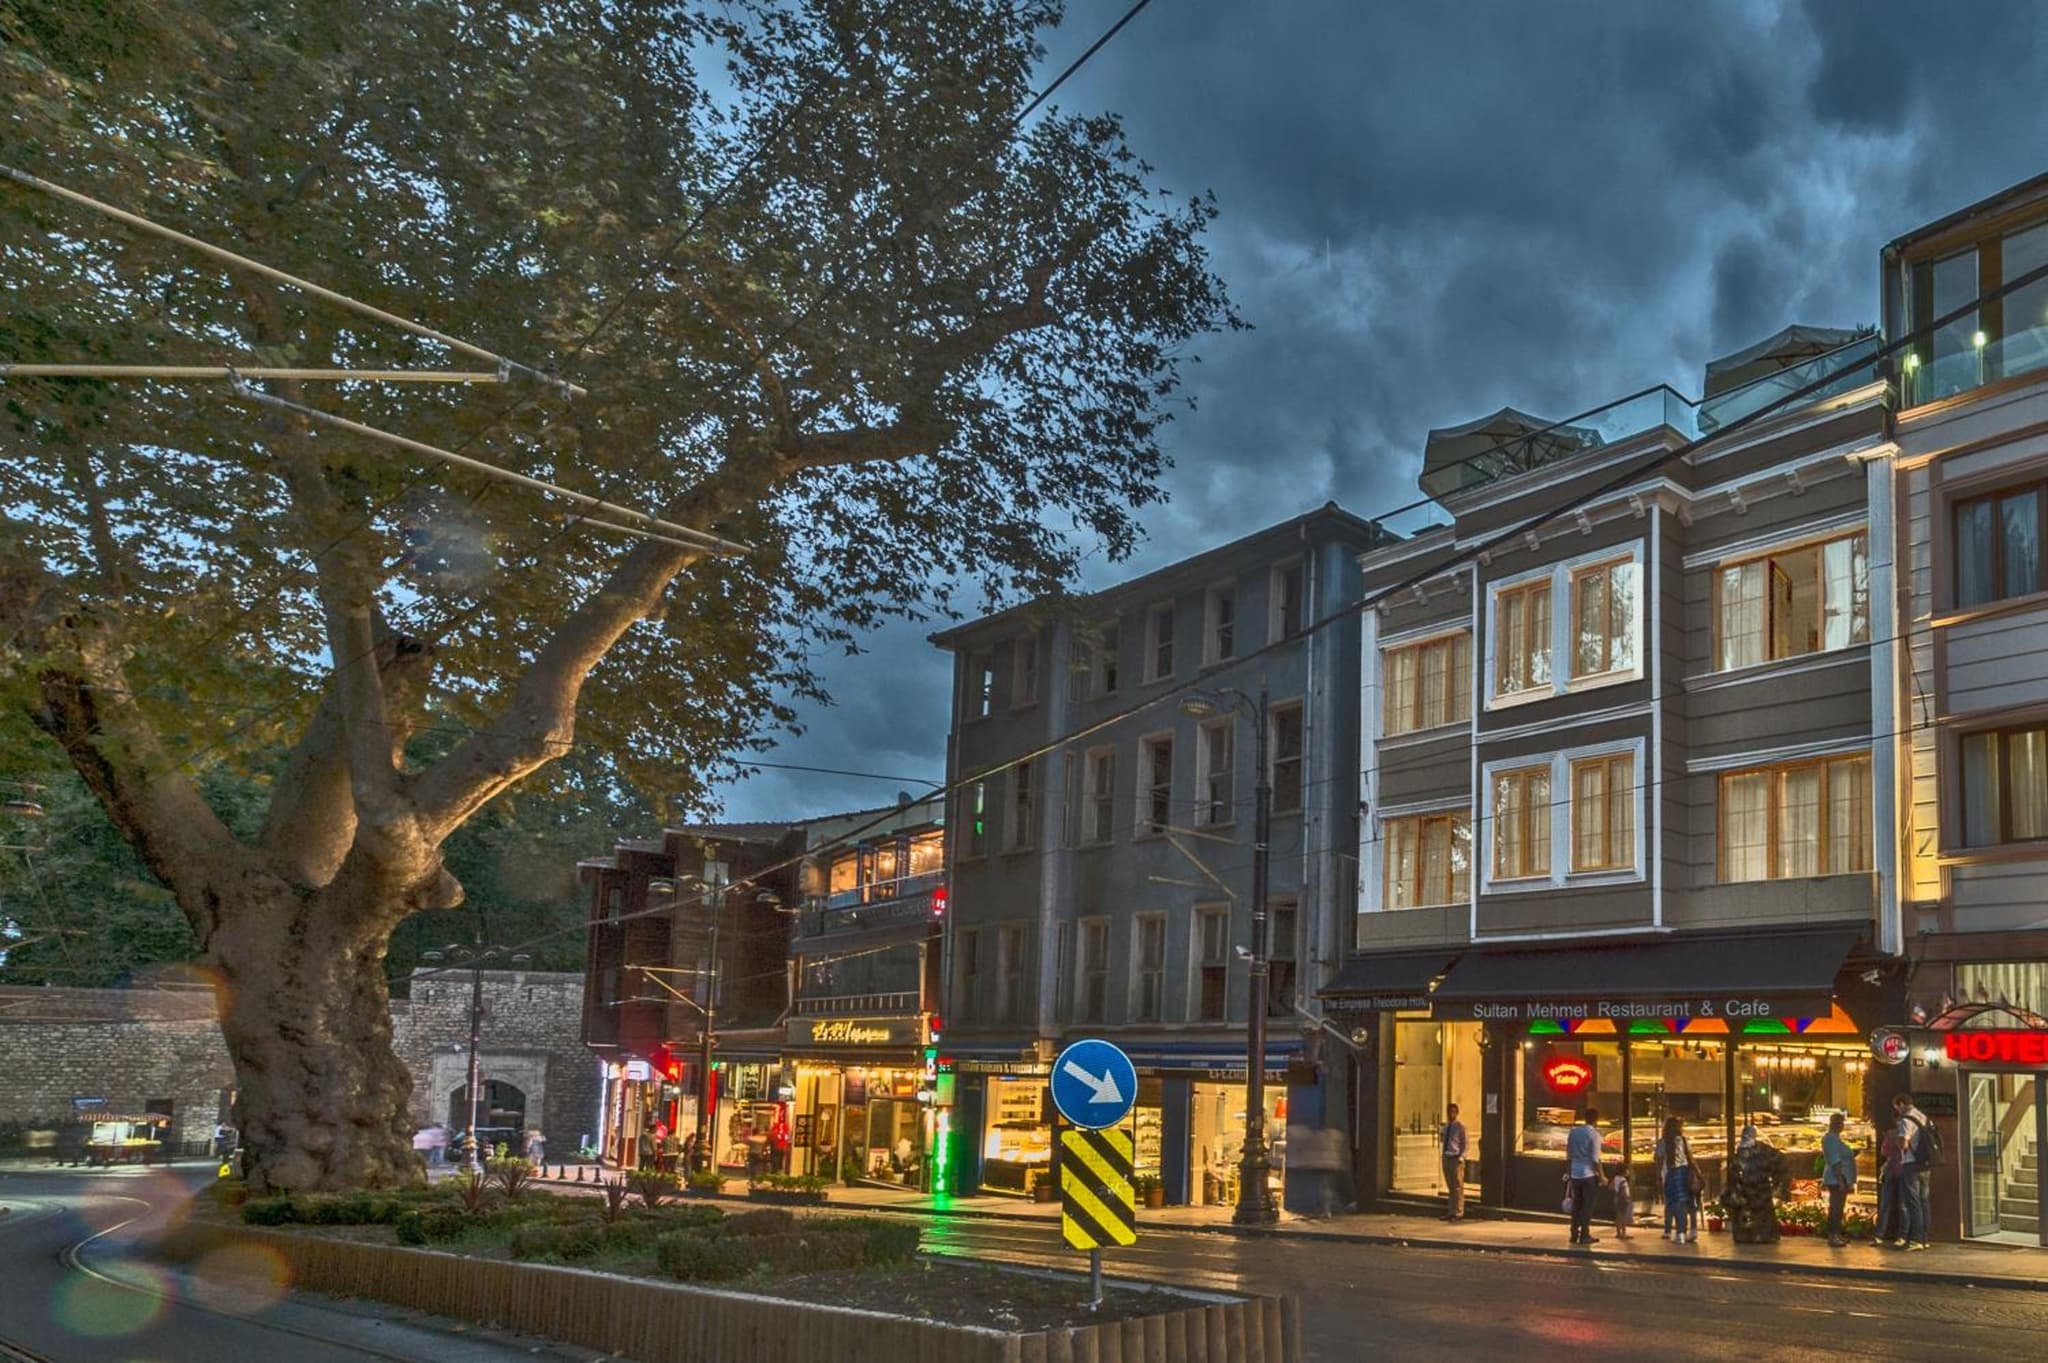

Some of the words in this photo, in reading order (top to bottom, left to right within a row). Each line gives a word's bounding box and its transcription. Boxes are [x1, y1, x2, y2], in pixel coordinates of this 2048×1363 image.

[1473, 1002, 1518, 1018] Sultan
[1527, 1002, 1588, 1017] Mehmet
[1598, 1001, 1690, 1017] Restaurant
[1700, 1000, 1714, 1016] &
[1725, 999, 1770, 1016] Cafe
[1944, 1031, 2048, 1064] HOTE
